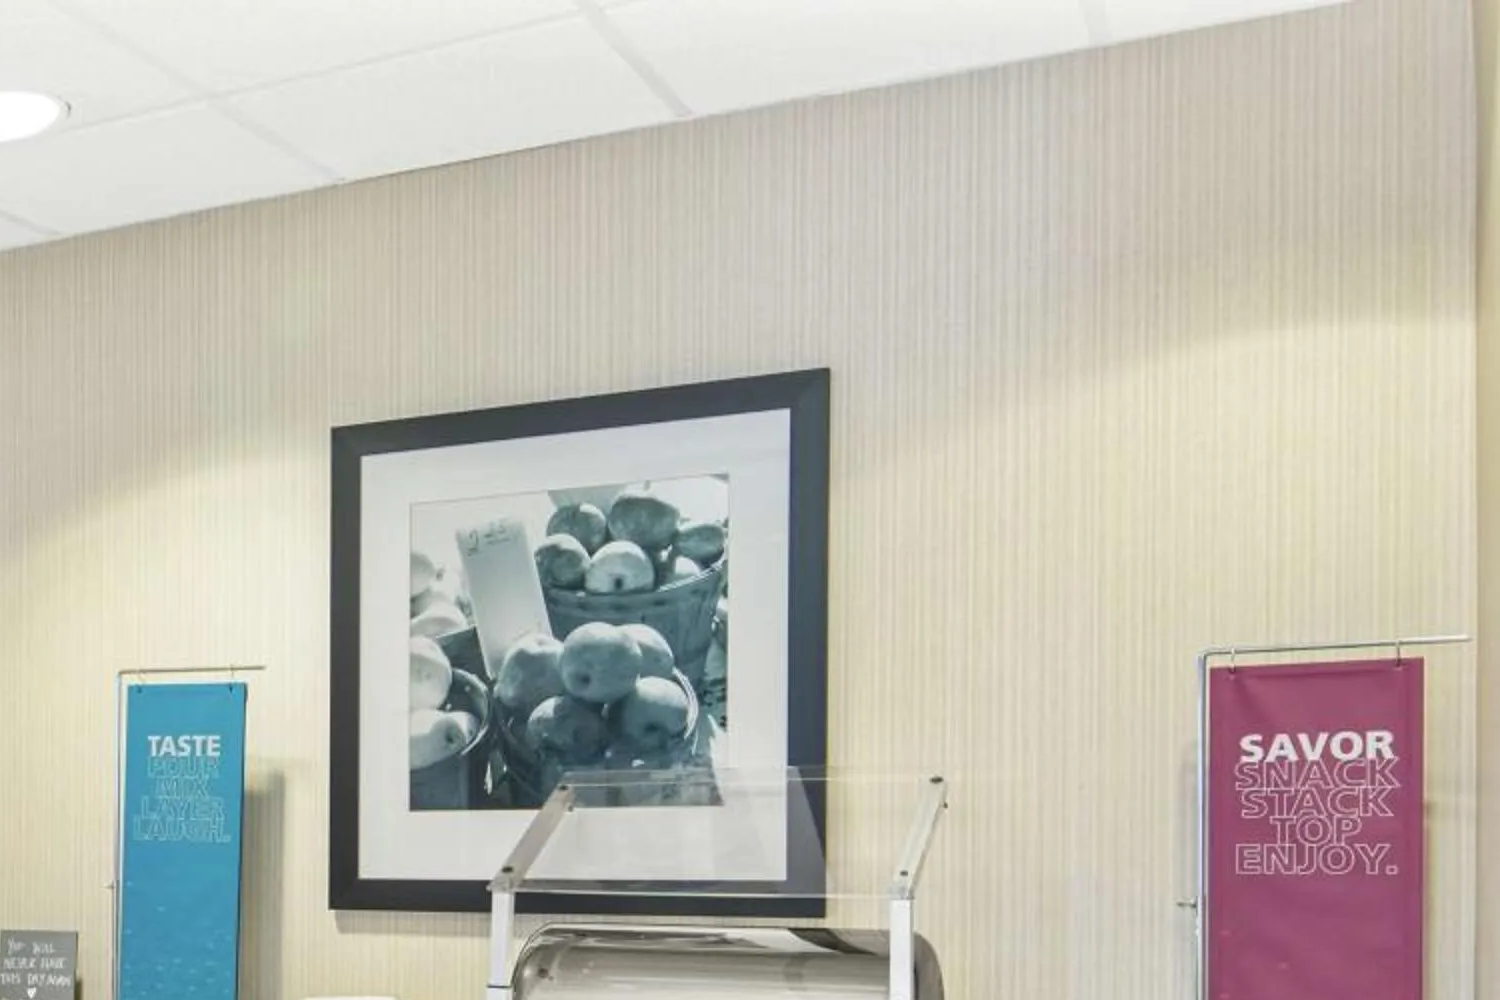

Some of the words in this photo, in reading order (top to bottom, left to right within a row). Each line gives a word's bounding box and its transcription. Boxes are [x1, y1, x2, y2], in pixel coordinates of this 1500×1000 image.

[147, 735, 221, 757] TASTE
[1238, 730, 1395, 763] SAVOR
[1235, 757, 1400, 790] SNACK
[1241, 786, 1394, 818] STACK
[1269, 815, 1362, 846] TOP
[1235, 843, 1398, 875] ENJOY.
